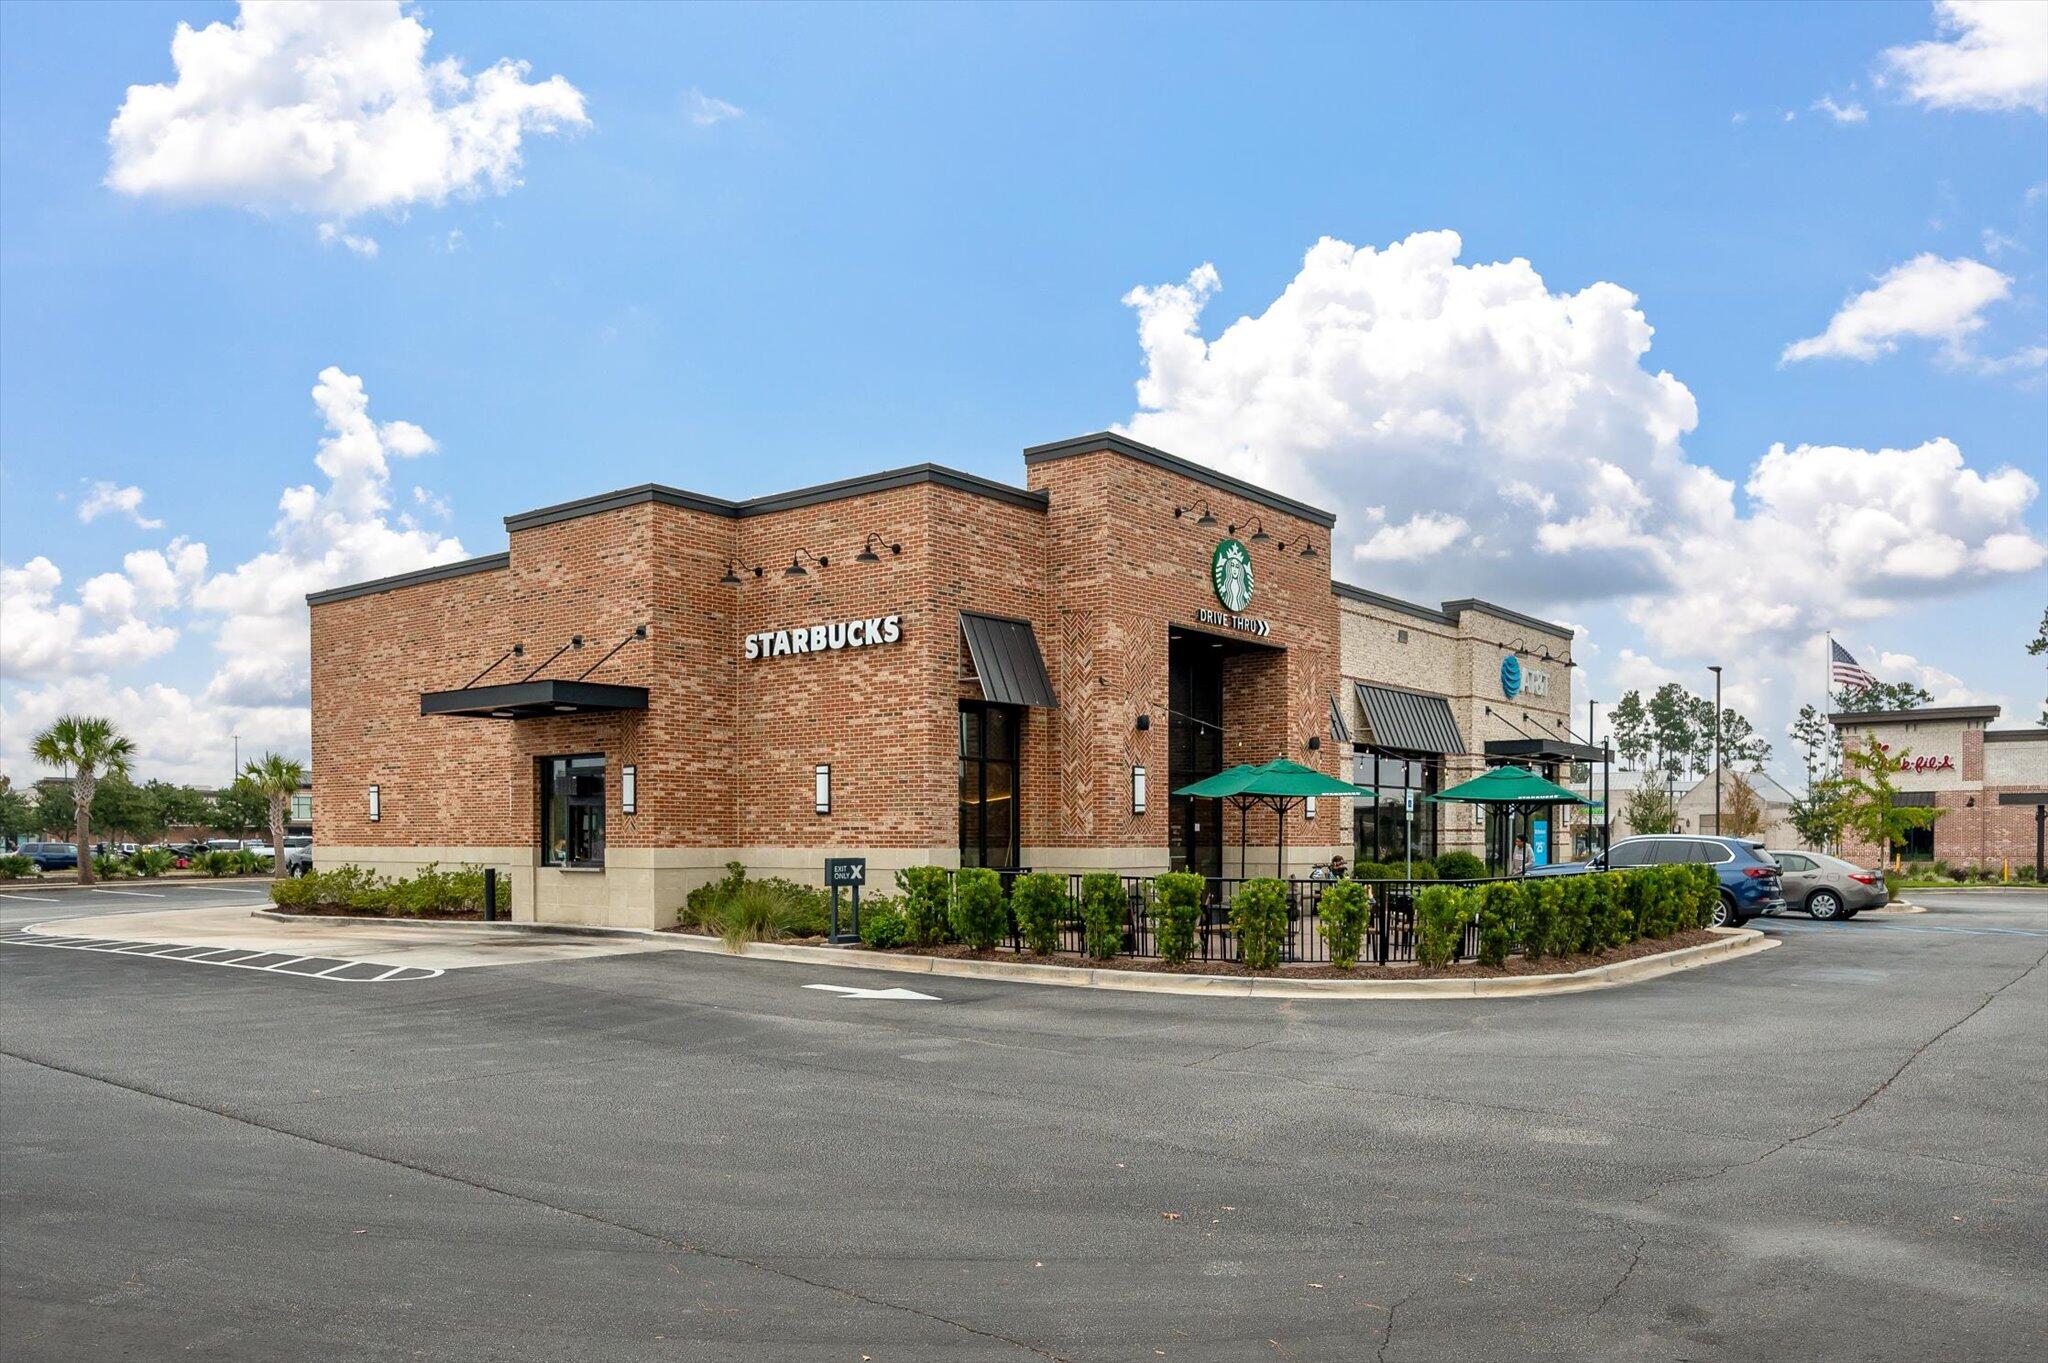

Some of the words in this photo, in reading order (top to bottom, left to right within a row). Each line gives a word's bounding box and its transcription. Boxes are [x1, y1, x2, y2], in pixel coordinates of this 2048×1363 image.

[1199, 608, 1229, 628] DRIVE
[1231, 615, 1257, 633] THRU
[745, 615, 901, 660] STARBUCKS
[834, 865, 848, 873] EXIT
[834, 872, 851, 880] ONLY
